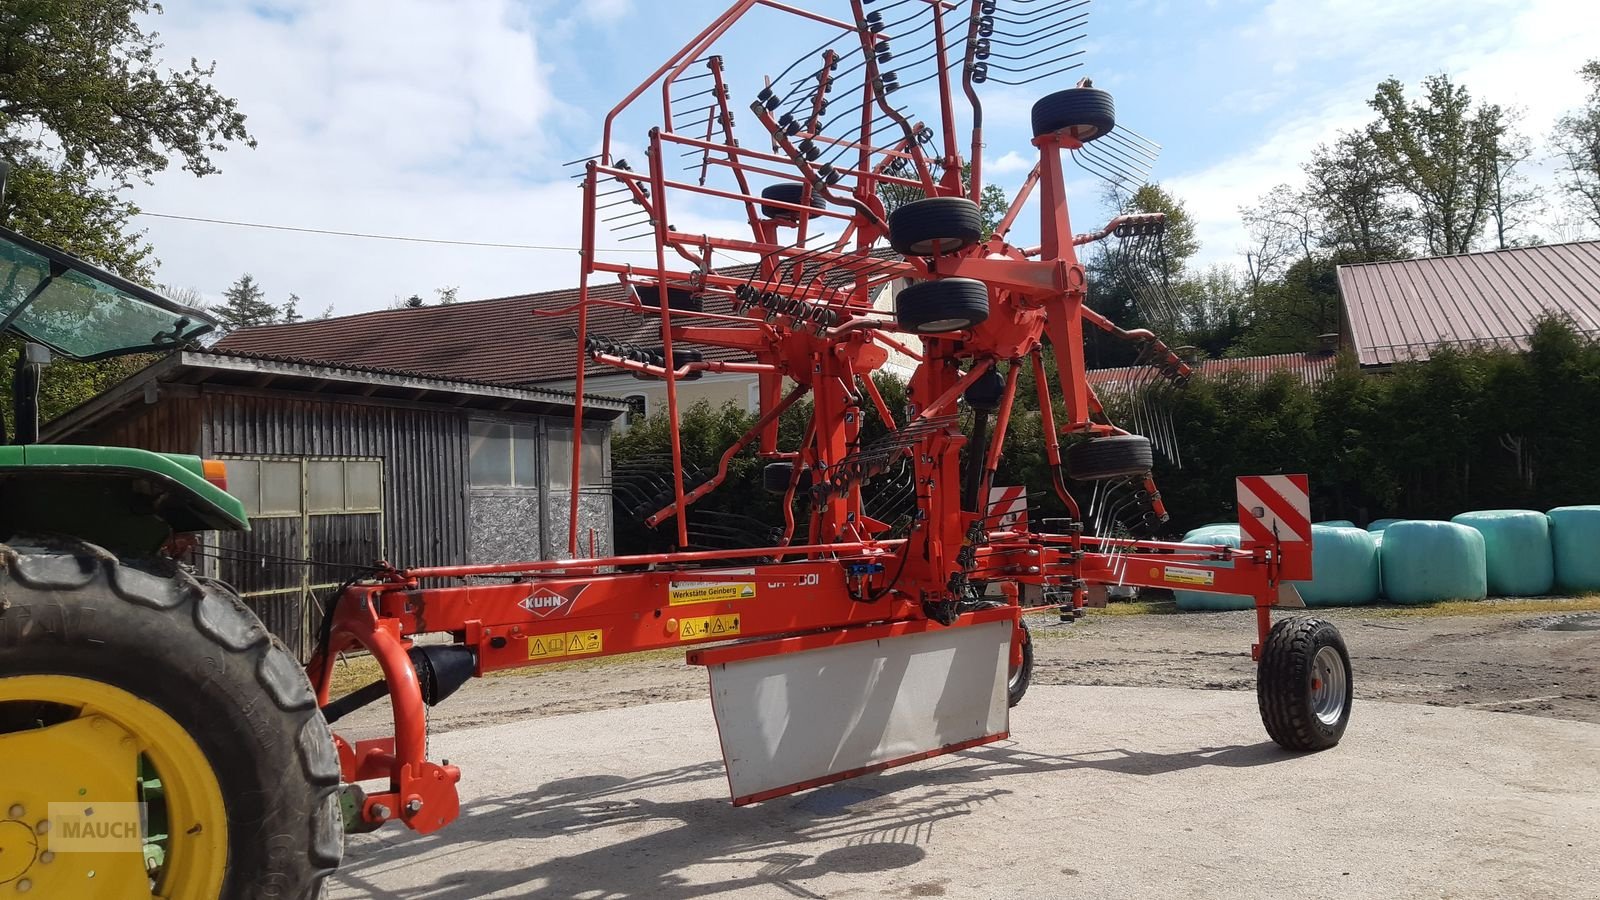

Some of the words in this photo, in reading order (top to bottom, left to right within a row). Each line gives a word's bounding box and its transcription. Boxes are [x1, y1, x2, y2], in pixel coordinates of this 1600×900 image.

[672, 590, 707, 599] Werkstätte
[708, 587, 737, 596] Geinberg
[525, 596, 561, 609] KUHN
